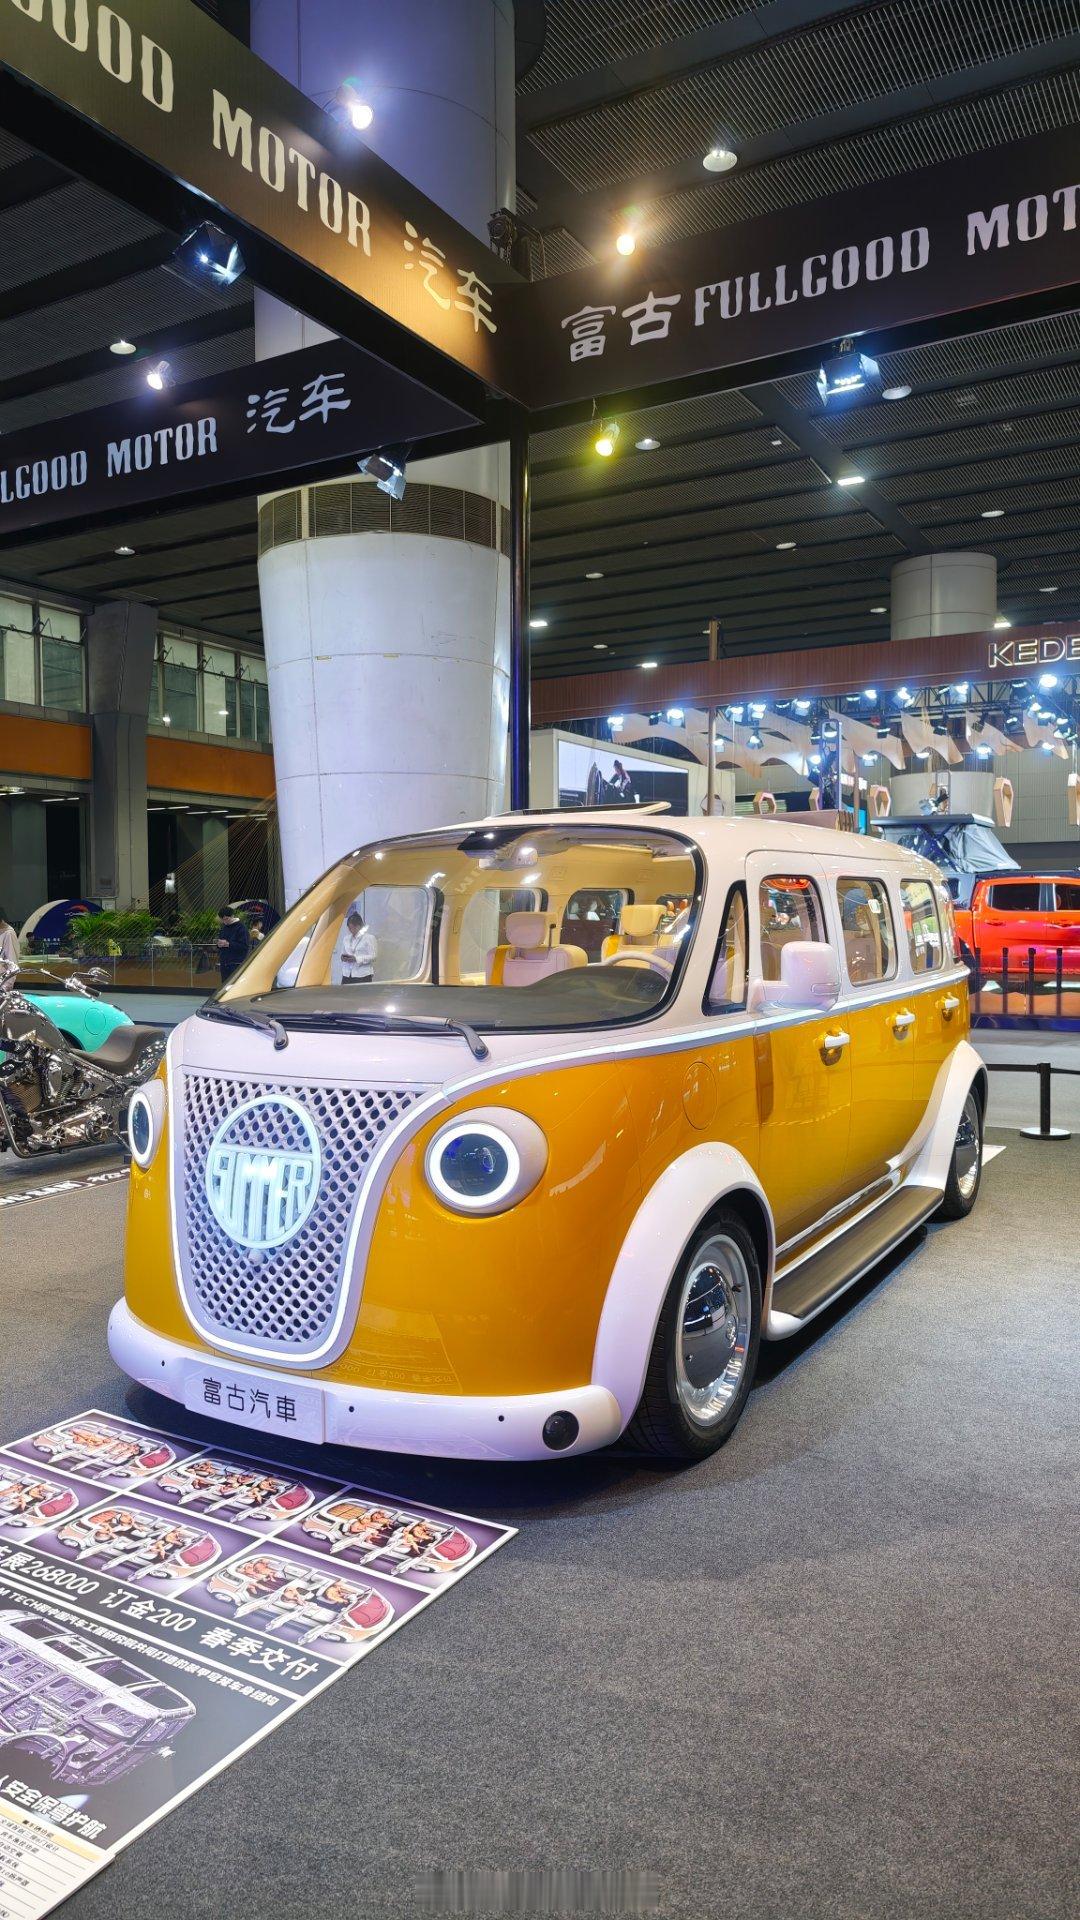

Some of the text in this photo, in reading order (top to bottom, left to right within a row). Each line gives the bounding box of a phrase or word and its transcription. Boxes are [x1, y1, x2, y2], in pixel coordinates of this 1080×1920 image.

[212, 89, 372, 257] MOTOR
[403, 220, 498, 334] 汽车
[560, 183, 1080, 362] 富古 FULLGOOD MOT
[0, 372, 352, 504] LGOOD MOTOR 汽车
[987, 634, 1080, 668] KEDE
[202, 1376, 298, 1424] 富古汽車
[99, 1588, 197, 1632] 订金200
[199, 1626, 319, 1681] 春季交付
